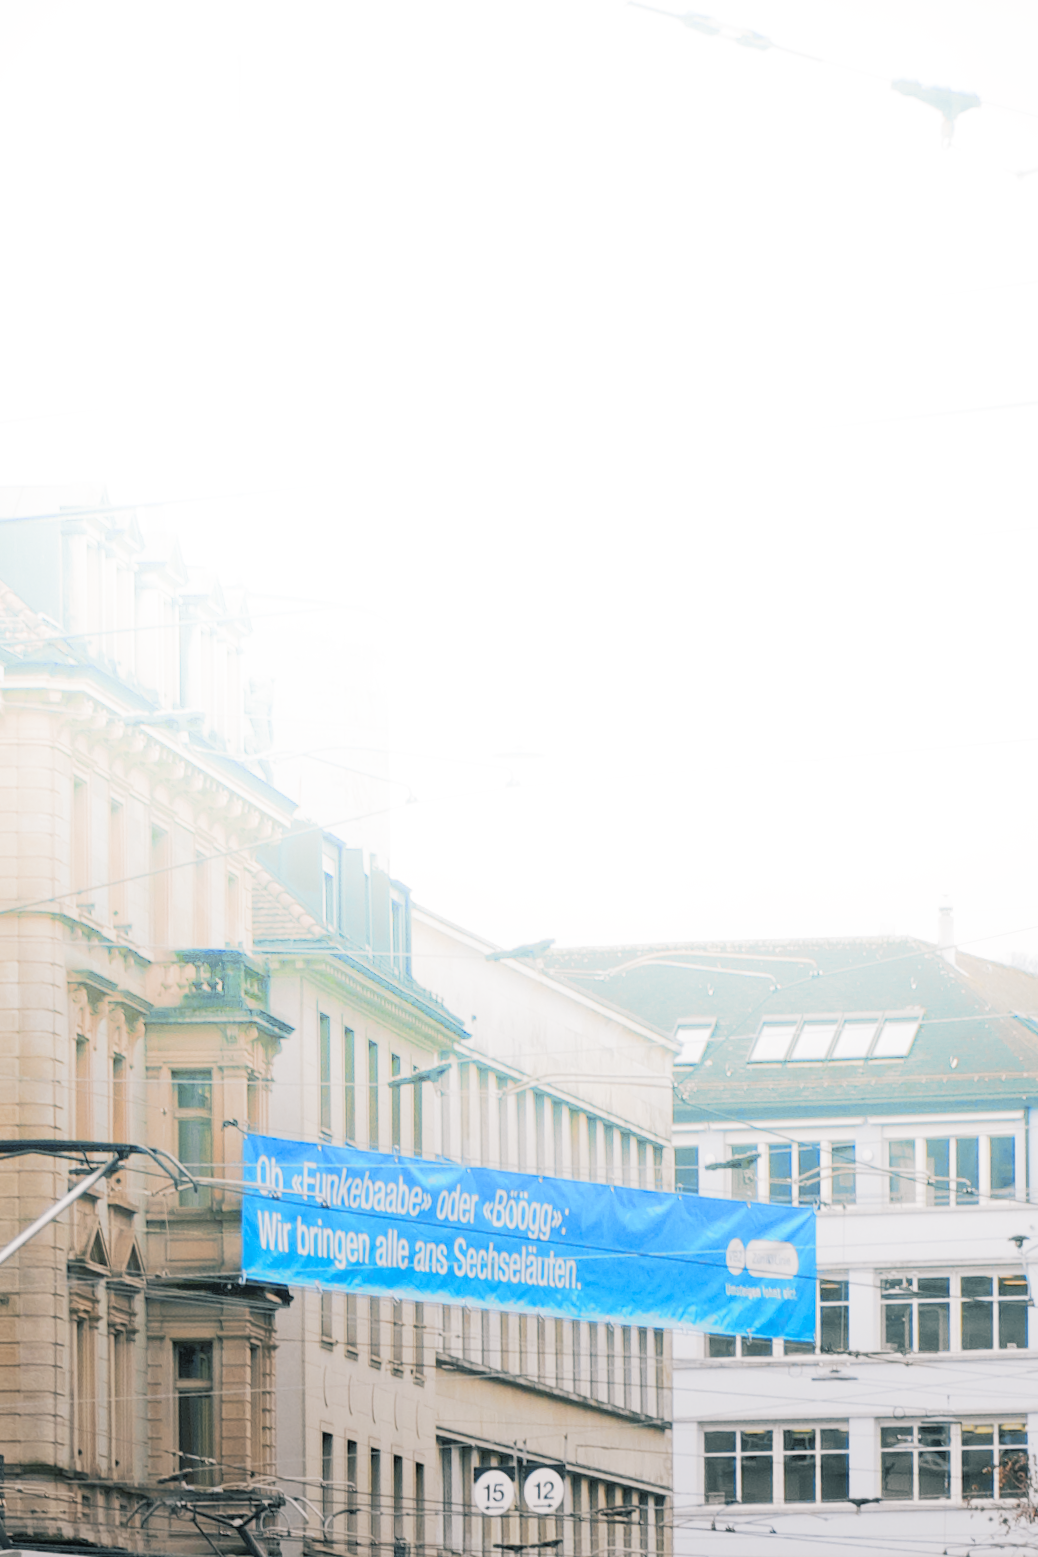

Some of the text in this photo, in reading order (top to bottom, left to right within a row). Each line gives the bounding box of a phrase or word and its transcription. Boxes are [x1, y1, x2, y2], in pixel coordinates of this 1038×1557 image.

[256, 1154, 570, 1241] Ob «Funkebaabe» oder «Böögg»:
[257, 1209, 582, 1290] Wir bringen alle ans Sechseläuten.
[483, 1483, 504, 1502] 15
[533, 1481, 555, 1500] 12
